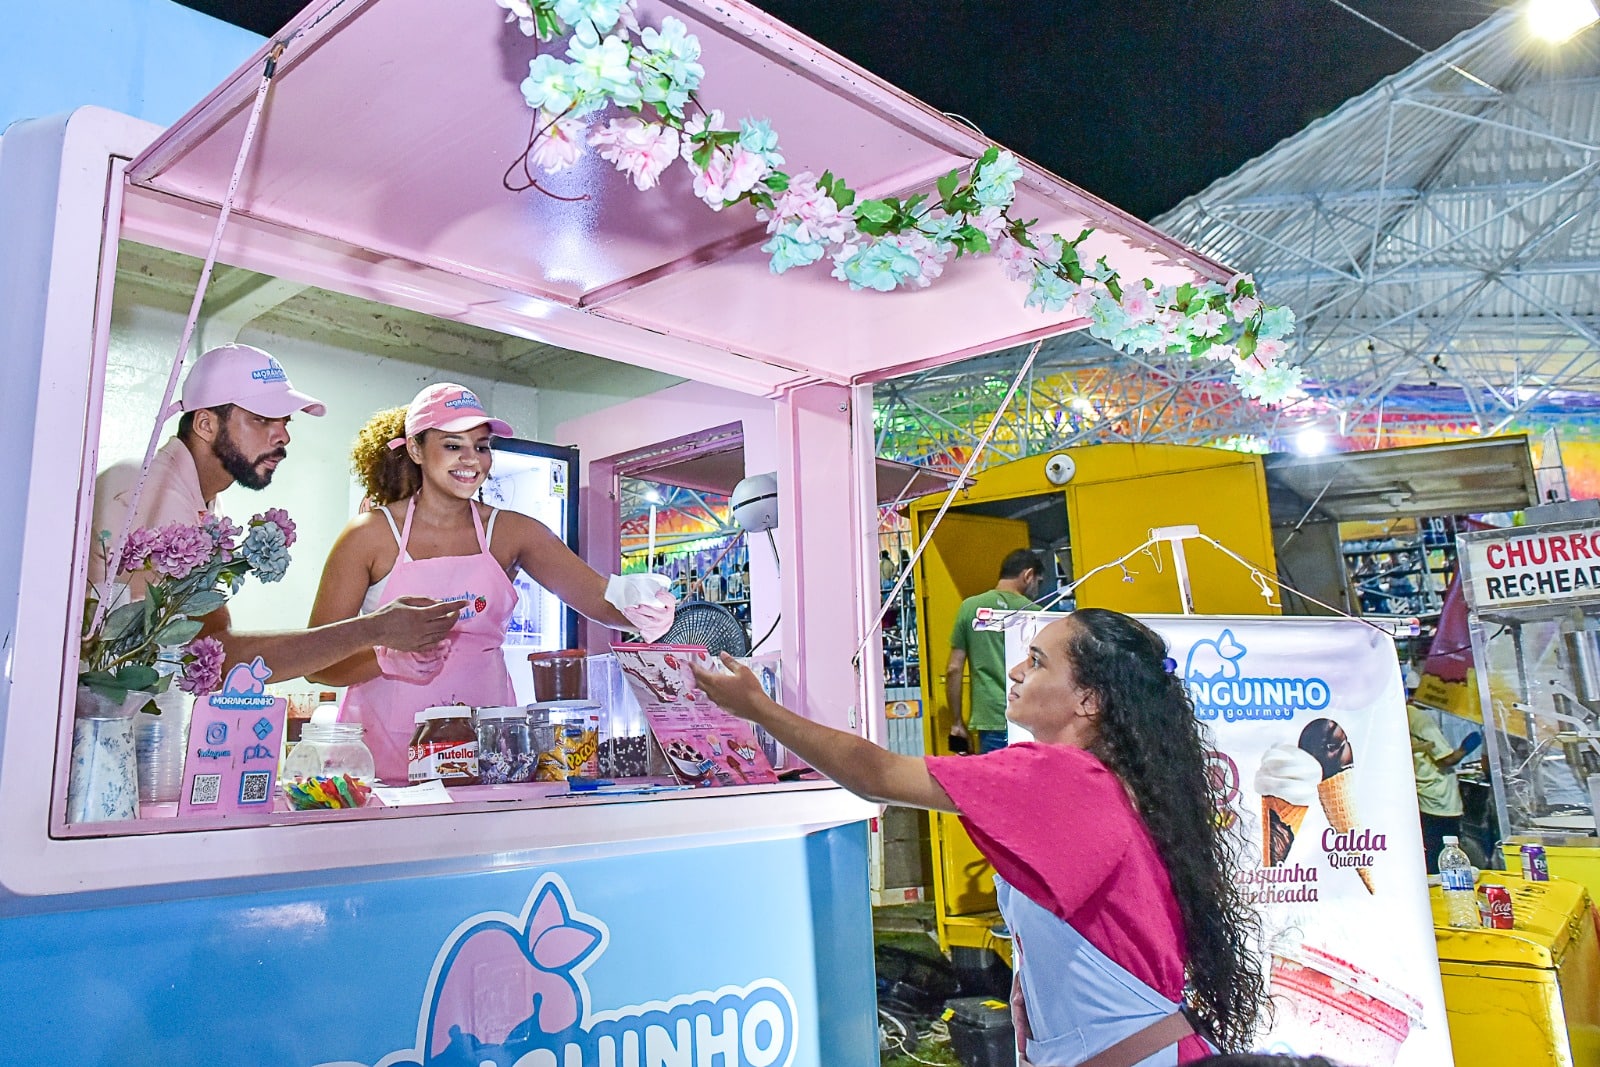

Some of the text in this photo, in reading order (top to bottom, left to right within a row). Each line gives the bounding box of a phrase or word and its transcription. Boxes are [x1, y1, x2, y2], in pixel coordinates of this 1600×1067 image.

[213, 696, 274, 706] MORANGUINHO
[1226, 707, 1291, 719] gourmet
[437, 748, 474, 760] nutella
[1321, 827, 1387, 852] Calda
[1327, 852, 1374, 869] Quente
[1491, 899, 1512, 913] Coca
